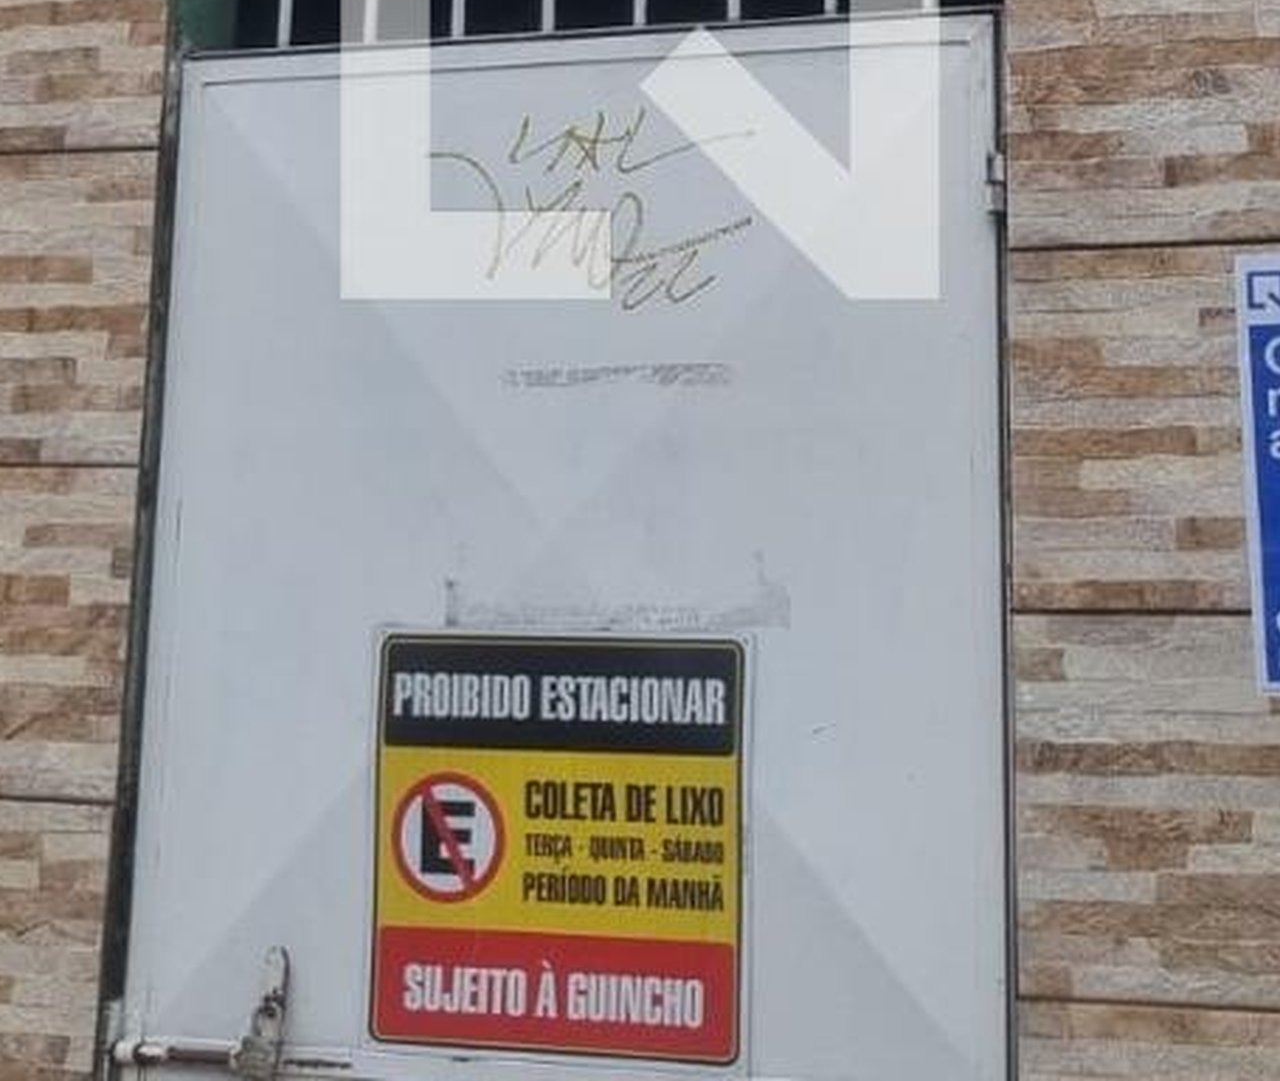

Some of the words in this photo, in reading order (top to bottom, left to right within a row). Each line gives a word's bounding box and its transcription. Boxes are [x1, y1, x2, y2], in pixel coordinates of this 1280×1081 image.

[392, 672, 529, 719] PROIBIDO
[541, 676, 725, 725] ESTACIONAR
[524, 780, 617, 822] COLETA
[625, 784, 657, 823] DE
[666, 786, 724, 826] LIXO
[525, 833, 573, 864] TERÇA
[589, 835, 645, 863] QUINTA
[662, 834, 724, 865] SÁBADO
[522, 867, 607, 906] PERÍODO
[613, 875, 640, 907] DA
[646, 875, 724, 911] MANHÃ
[402, 962, 527, 1015] SUJEITO
[537, 960, 558, 1018] À
[566, 972, 705, 1029] GUINCHO
